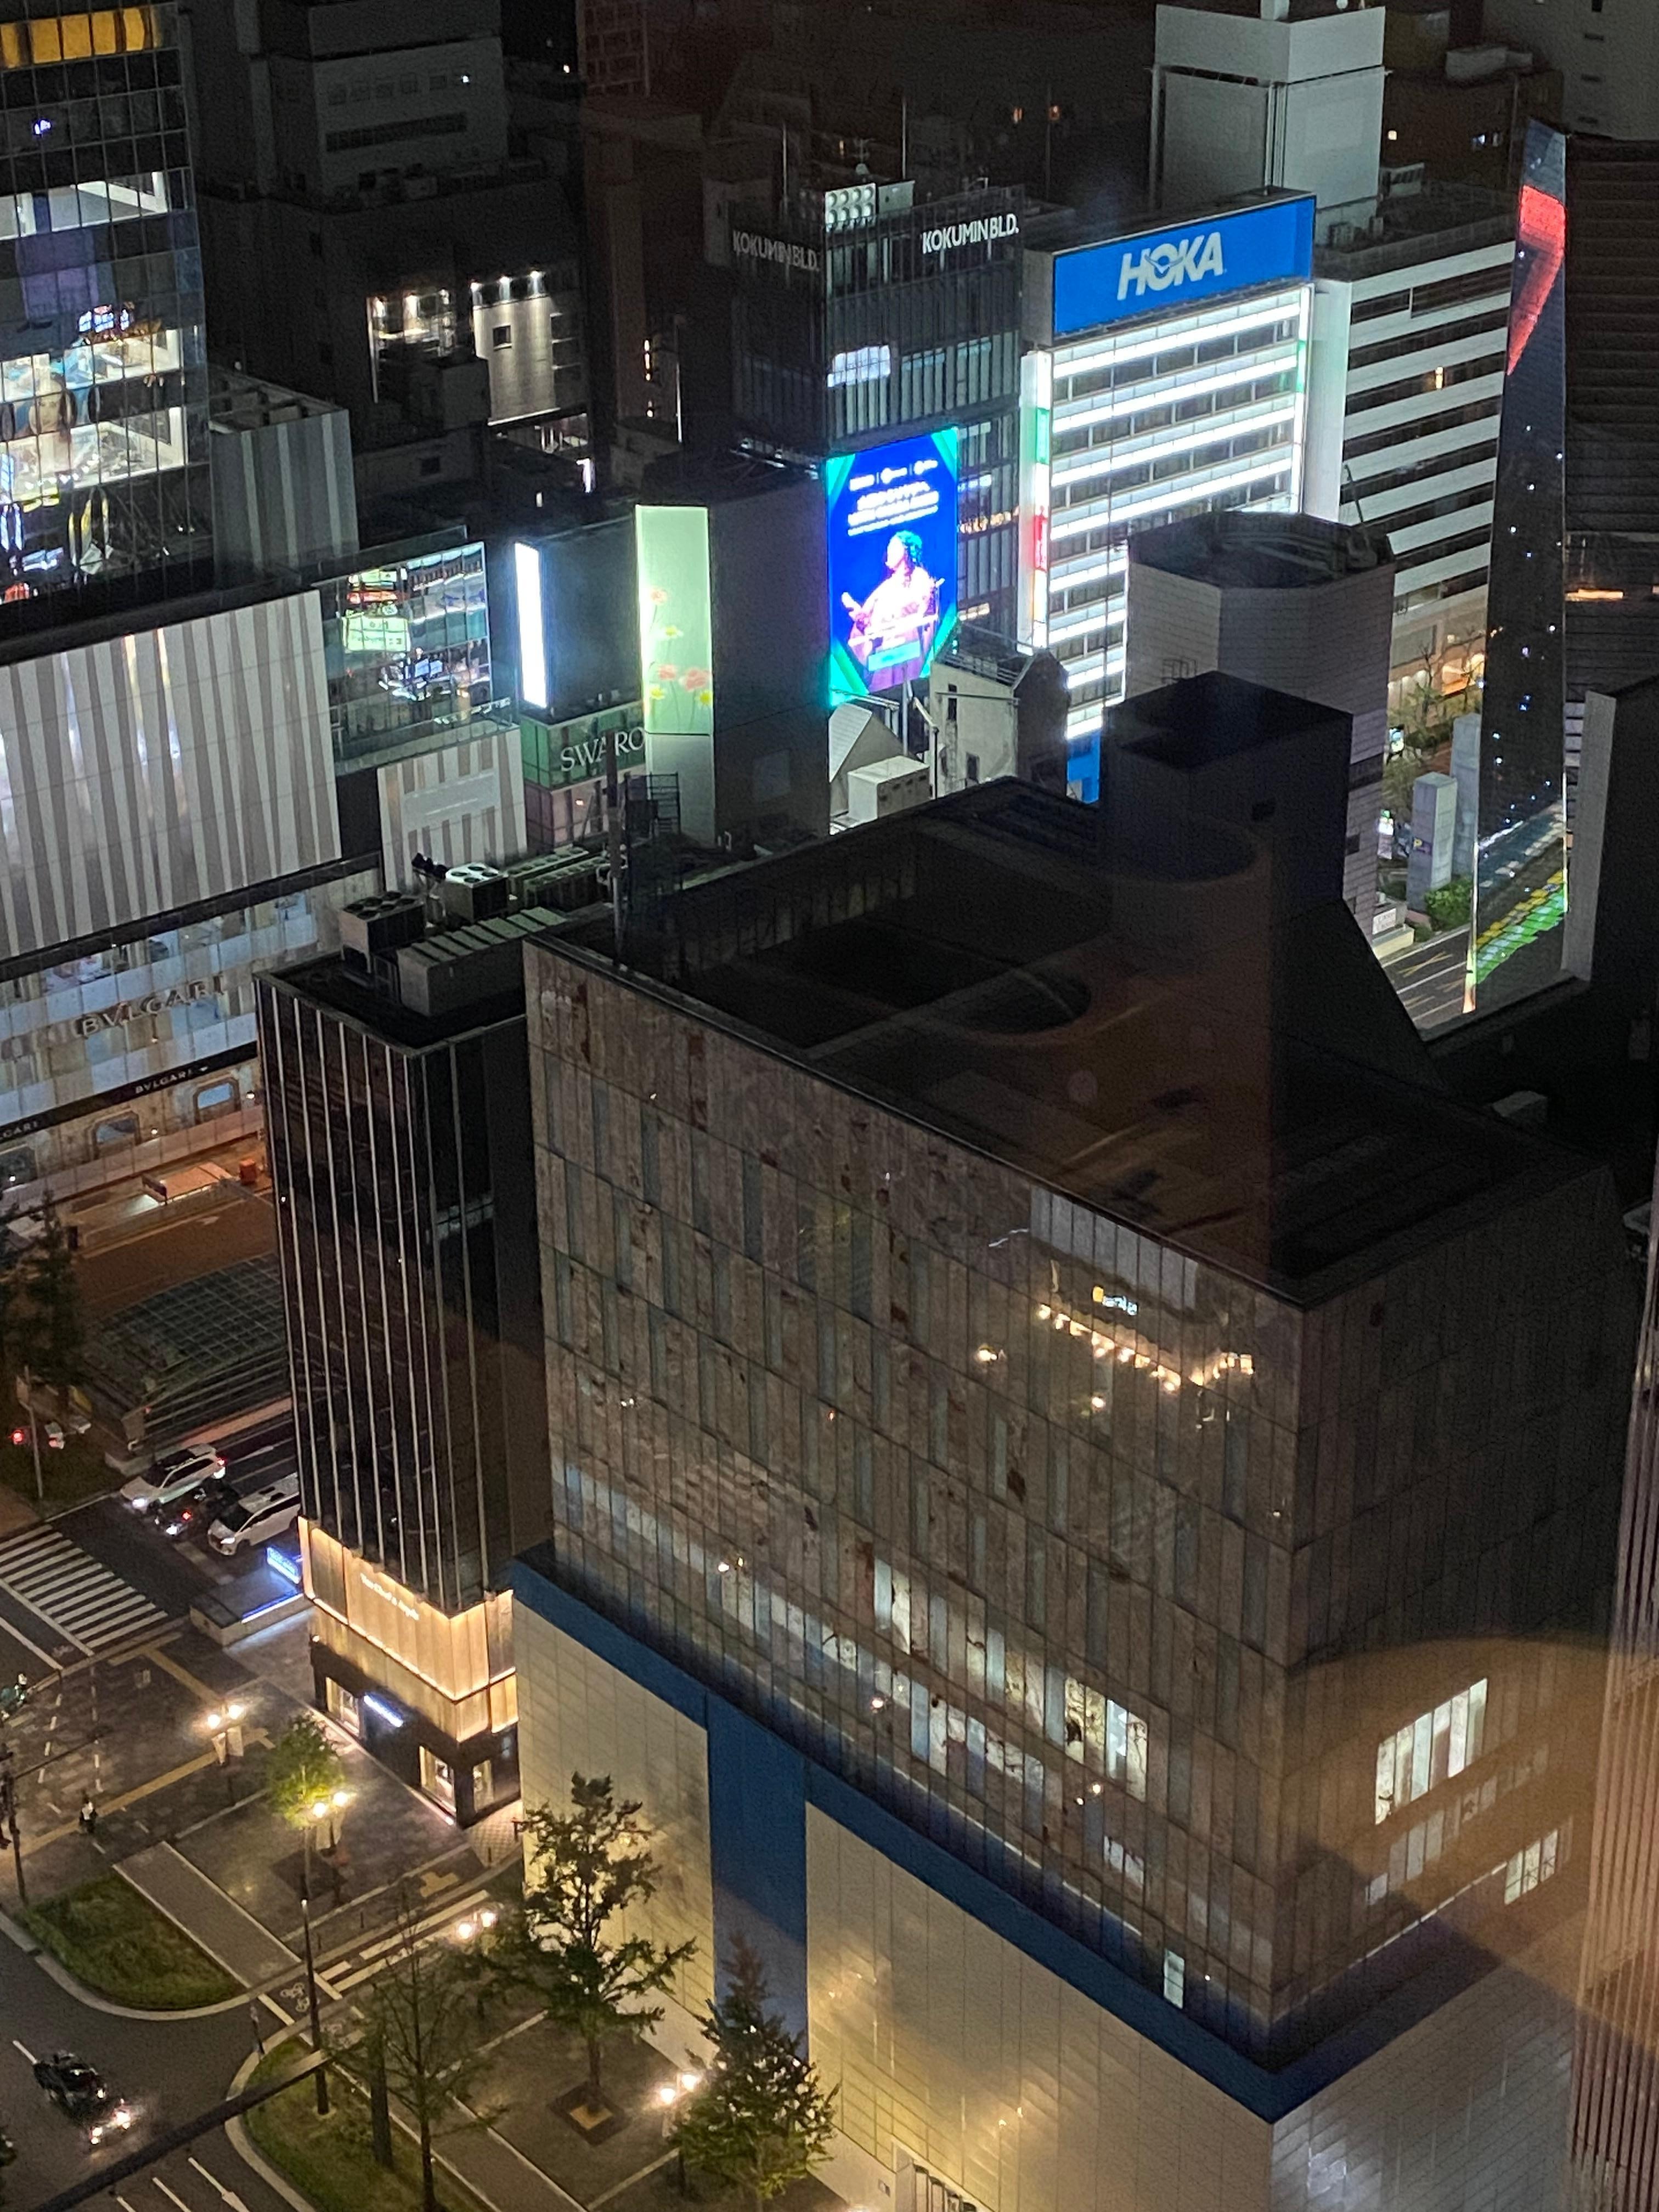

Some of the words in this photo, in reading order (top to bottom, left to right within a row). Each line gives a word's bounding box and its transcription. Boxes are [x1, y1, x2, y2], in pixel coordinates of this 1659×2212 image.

[1116, 231, 1223, 301] HOKA
[81, 974, 226, 1038] BVLGARI
[135, 1068, 192, 1094] BVLGARI
